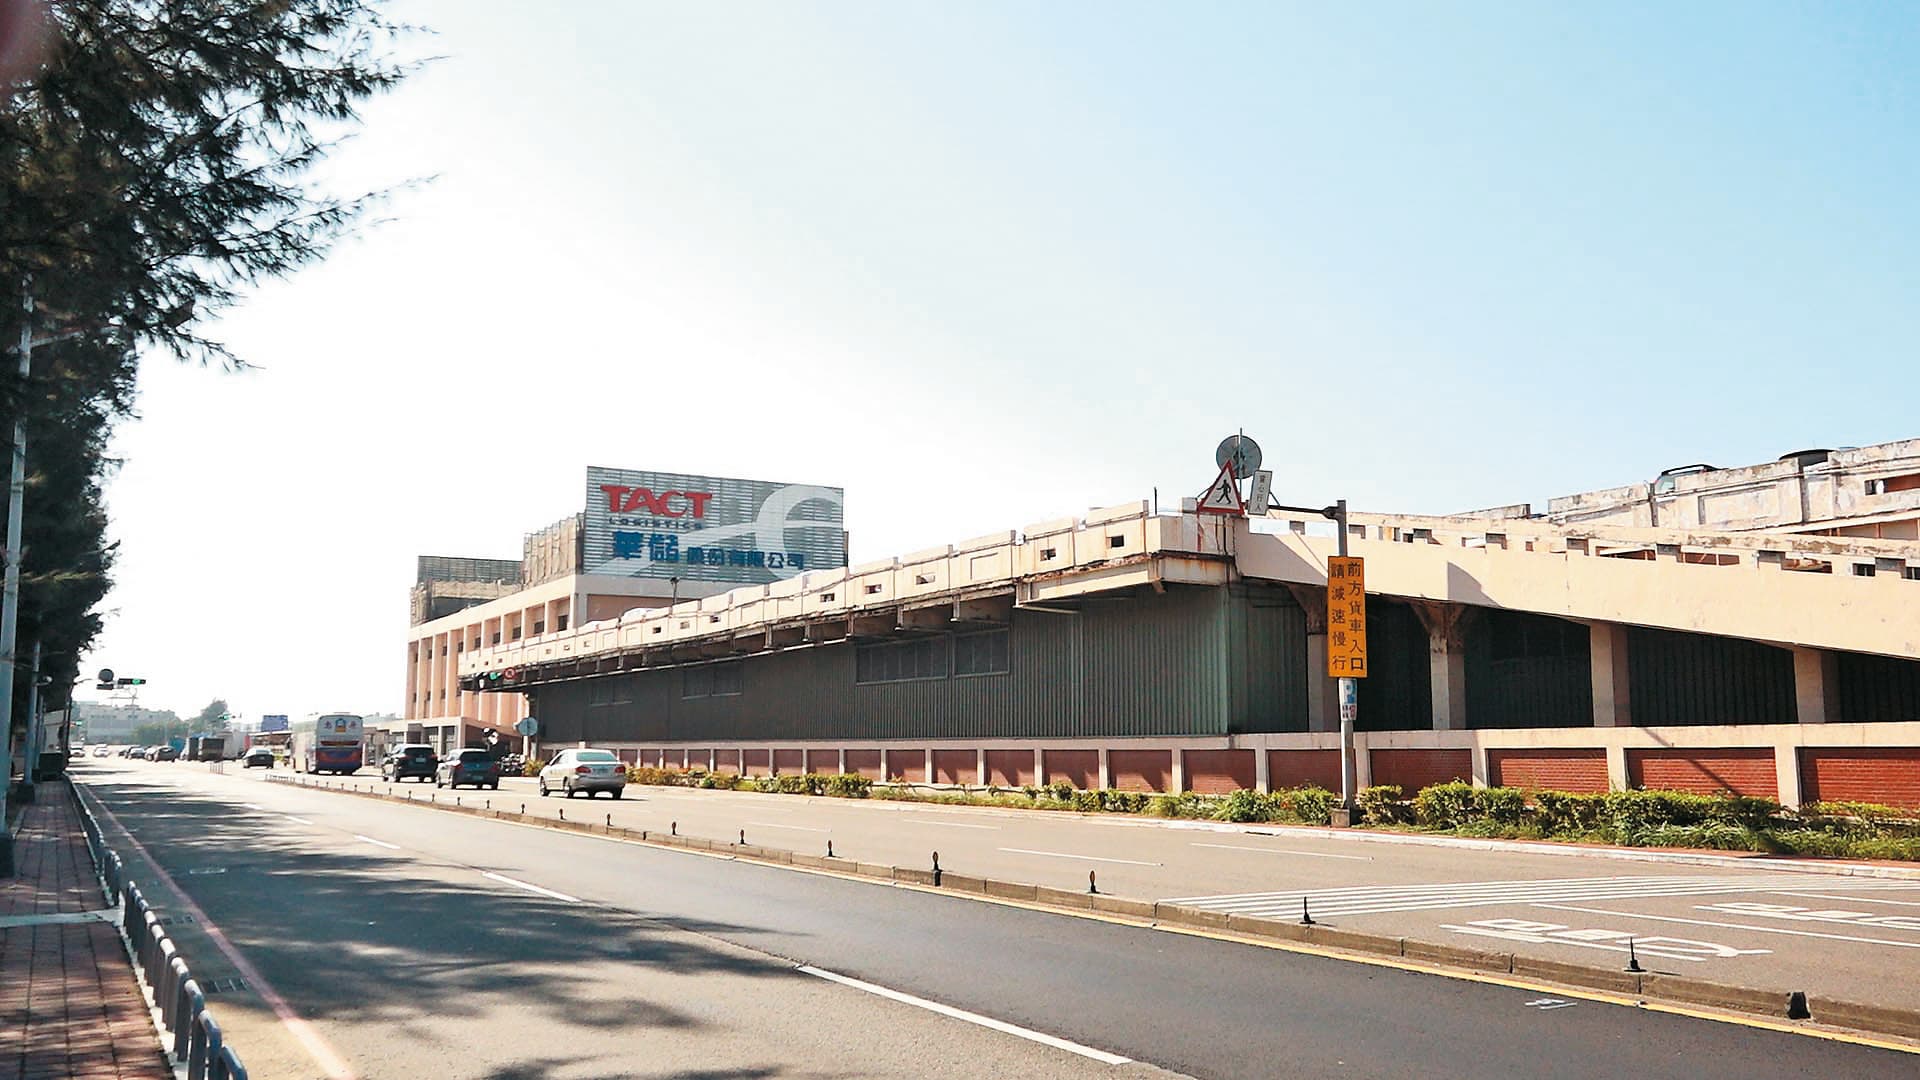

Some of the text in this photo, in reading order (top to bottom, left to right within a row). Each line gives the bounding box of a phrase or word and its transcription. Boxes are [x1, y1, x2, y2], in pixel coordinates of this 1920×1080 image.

[600, 484, 712, 518] TACT
[609, 517, 704, 529] LOGISTICS
[1330, 563, 1347, 671] 請減速慢行
[1347, 562, 1364, 671] 前方貨車入口
